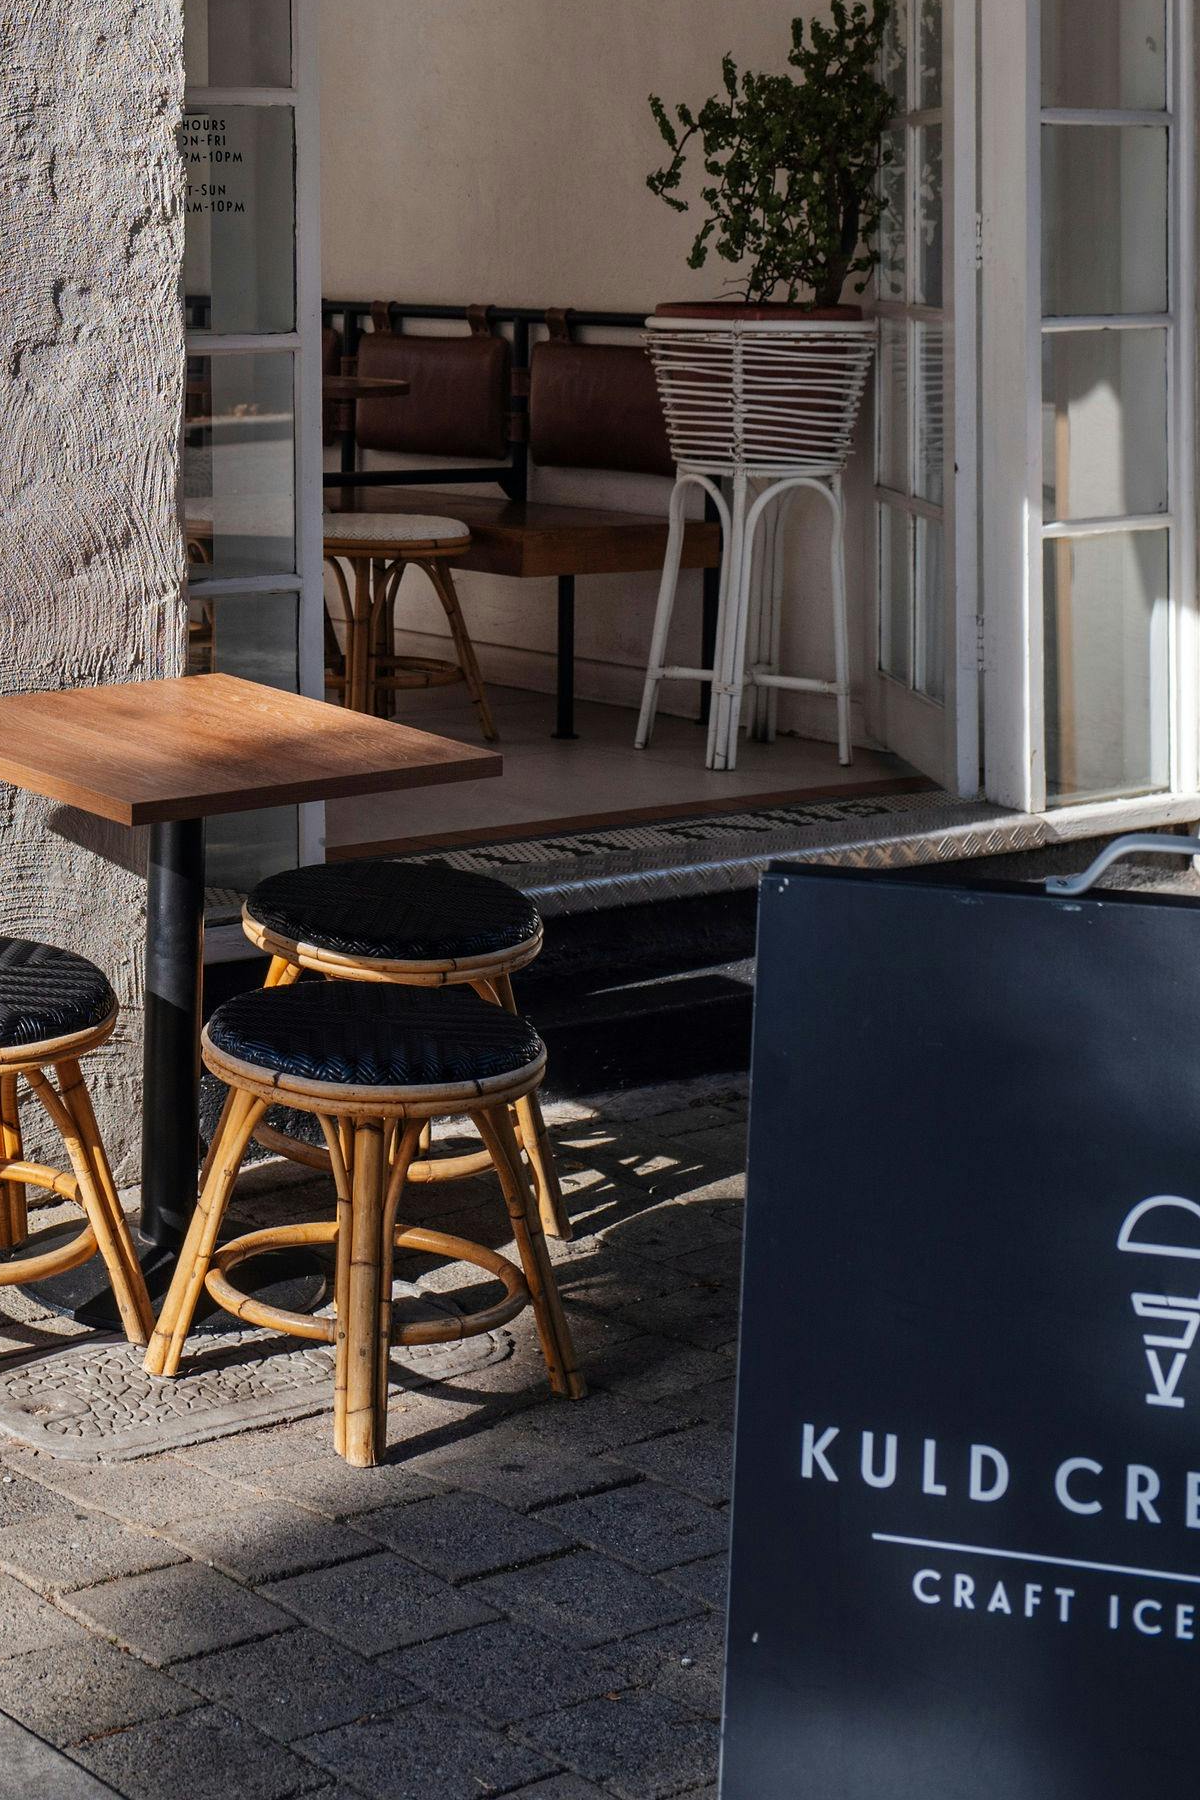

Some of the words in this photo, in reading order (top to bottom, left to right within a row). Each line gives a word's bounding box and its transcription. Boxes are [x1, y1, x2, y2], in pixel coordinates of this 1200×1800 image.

[183, 119, 226, 131] HOURS
[801, 1423, 1009, 1502] KULD
[912, 1569, 1075, 1622] CRAFT
[1110, 1594, 1195, 1639] ICE
